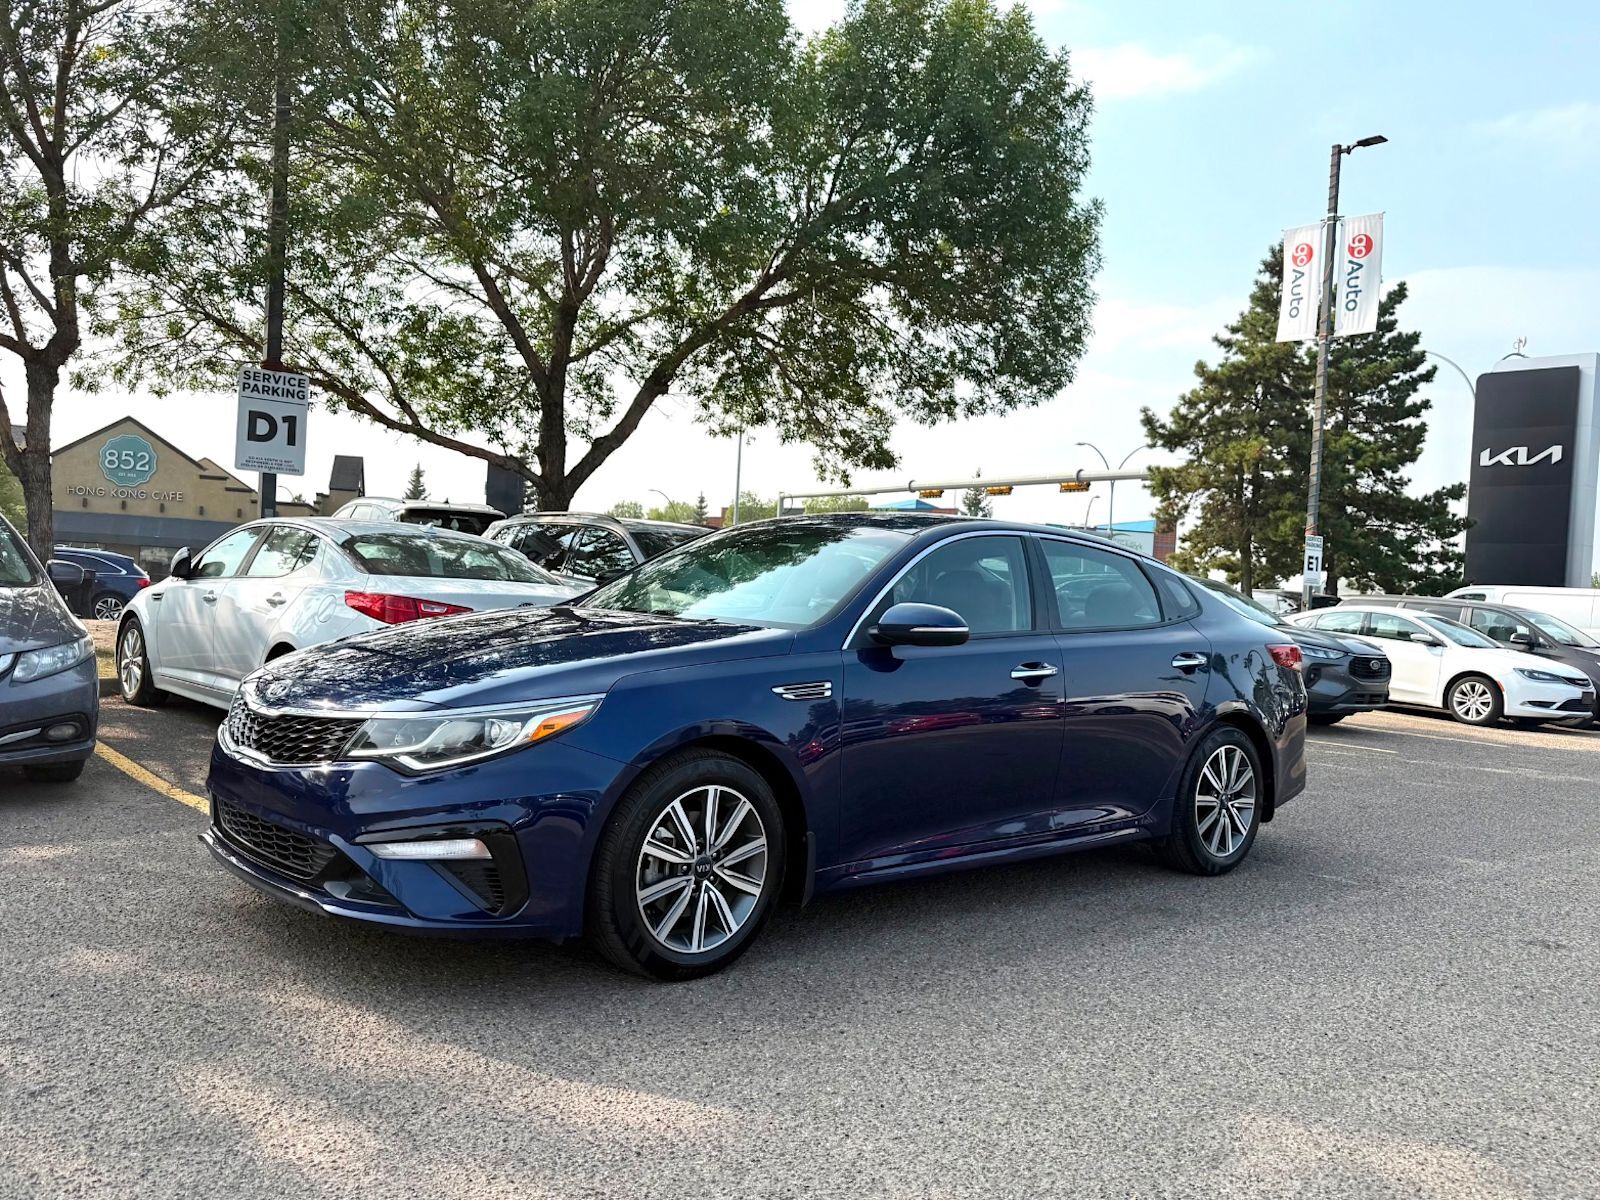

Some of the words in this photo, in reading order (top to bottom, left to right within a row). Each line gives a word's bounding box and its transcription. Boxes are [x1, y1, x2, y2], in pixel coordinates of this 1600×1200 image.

[1289, 268, 1305, 318] Auto
[1345, 260, 1364, 312] Auto
[243, 370, 306, 389] SERVICE
[242, 382, 306, 400] PARKING
[247, 409, 297, 447] D1
[104, 449, 150, 471] 852
[1479, 445, 1563, 466] KIA
[66, 486, 105, 496] HONG
[110, 488, 147, 500] KONG
[151, 490, 184, 501] CAFE
[1307, 556, 1319, 571] E1
